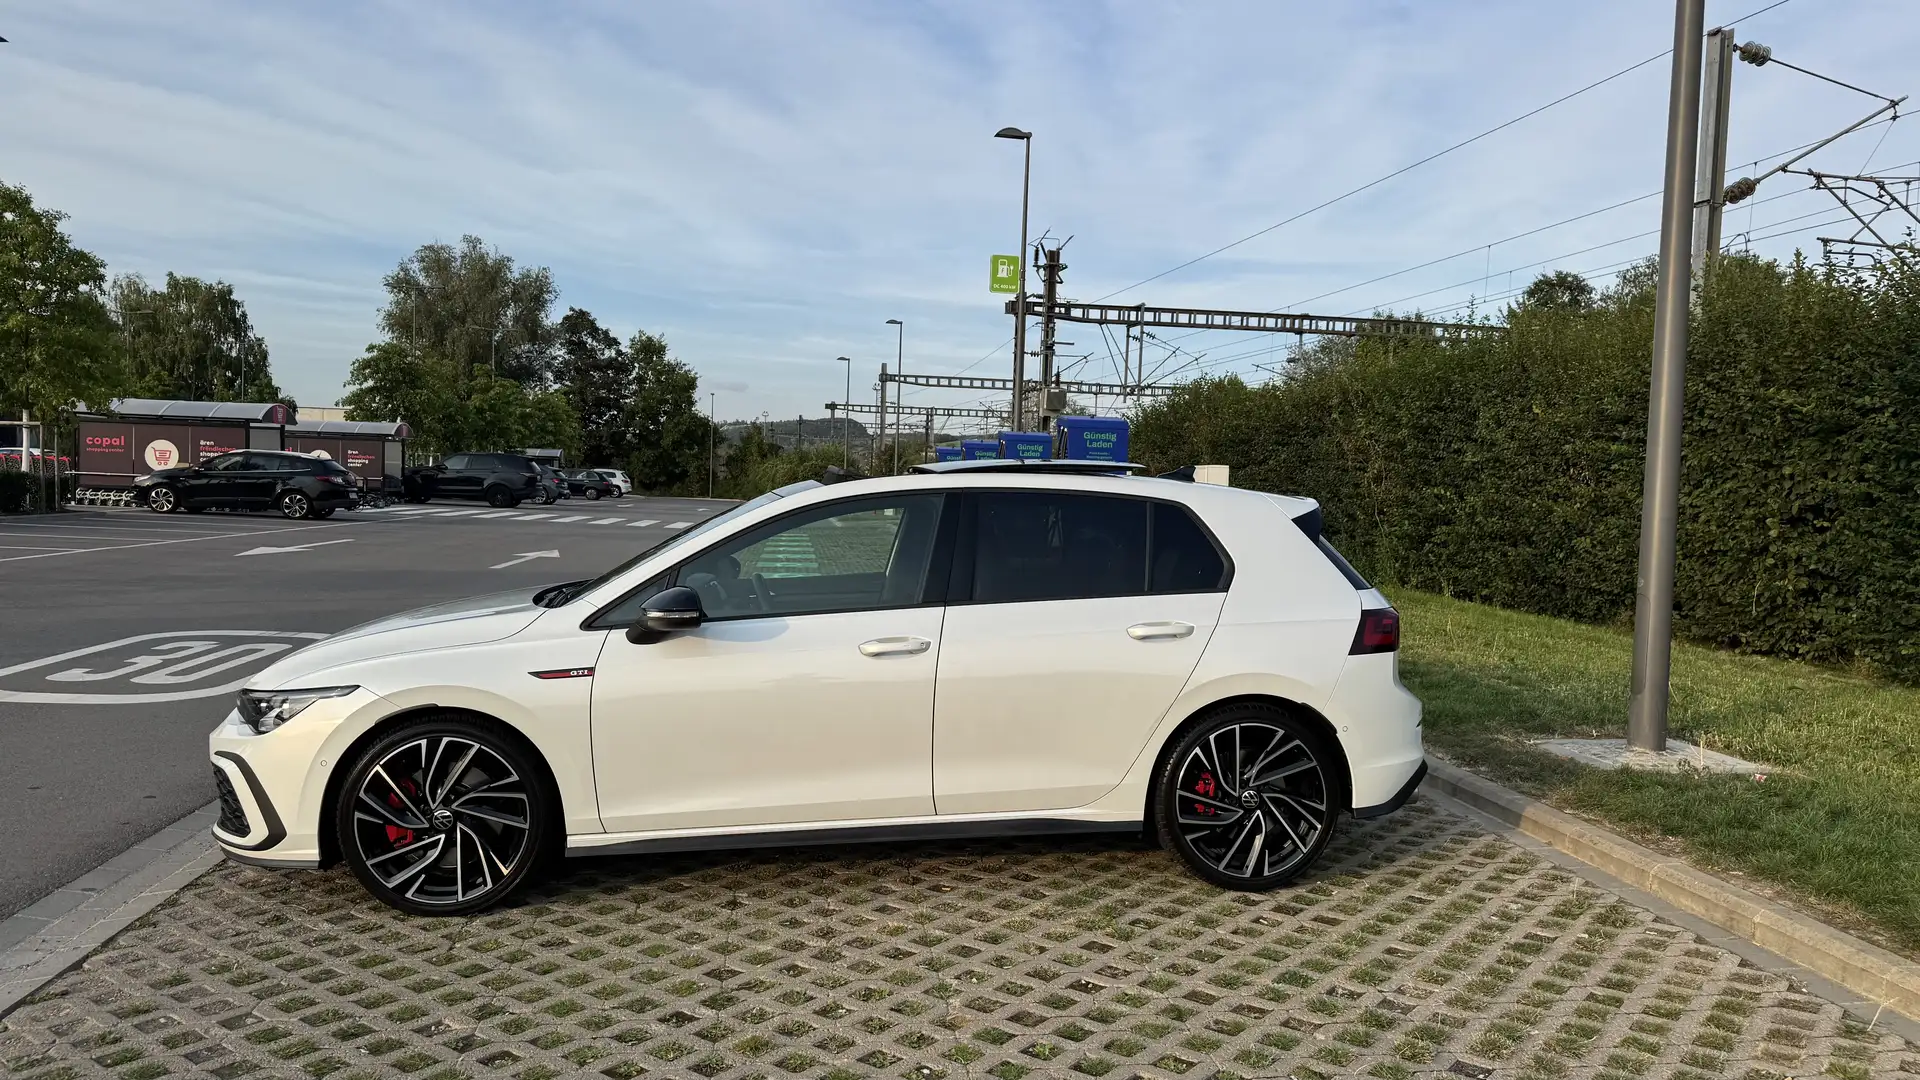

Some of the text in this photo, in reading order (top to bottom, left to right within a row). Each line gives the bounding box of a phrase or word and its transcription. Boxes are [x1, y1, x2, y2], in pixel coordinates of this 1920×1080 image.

[86, 435, 125, 447] copal
[1083, 431, 1117, 442] Günstig
[1017, 443, 1044, 452] Günstig
[1086, 440, 1113, 448] Laden
[974, 450, 997, 458] Günstig
[1019, 450, 1041, 458] Laden
[45, 641, 293, 684] 30
